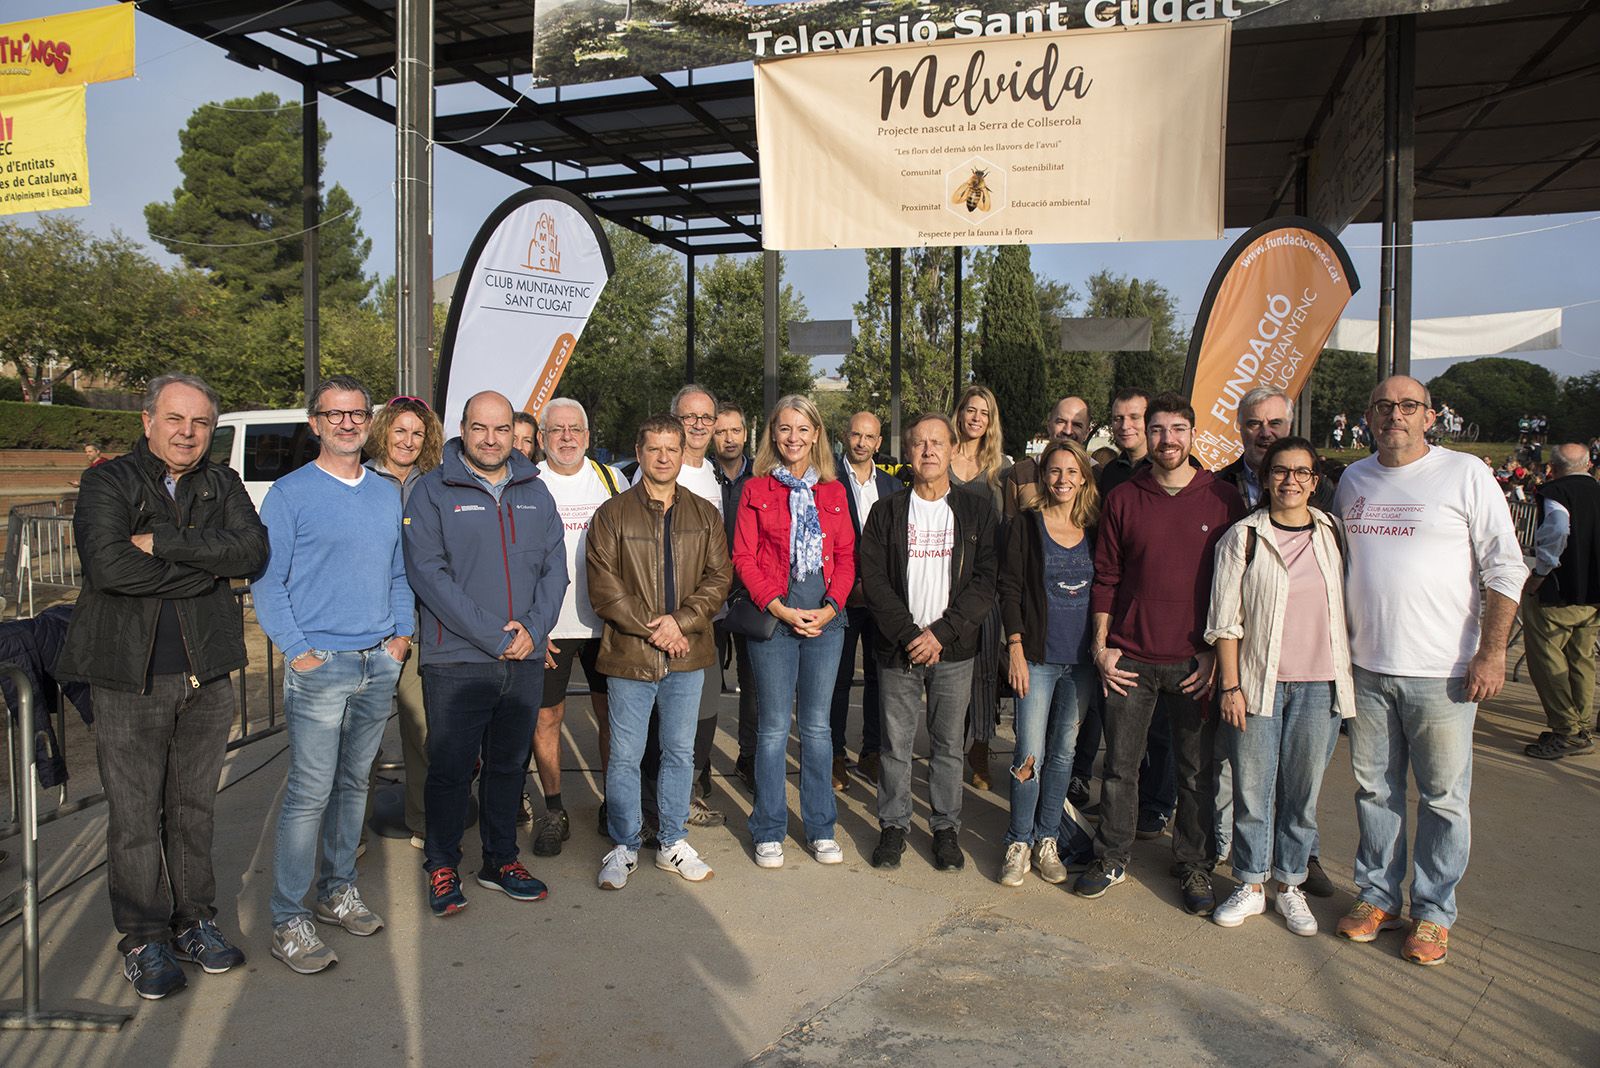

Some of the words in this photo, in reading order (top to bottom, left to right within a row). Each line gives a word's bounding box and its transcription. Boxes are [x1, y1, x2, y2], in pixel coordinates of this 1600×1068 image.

[748, 13, 939, 57] Televisió
[954, 1, 1068, 39] Sant
[1084, 0, 1242, 29] Cugat
[869, 43, 1093, 121] Melvida
[877, 126, 919, 138] Projecte
[921, 123, 956, 134] nascut
[958, 124, 965, 132] a
[967, 121, 977, 132] la
[979, 121, 1008, 131] Serra
[1010, 118, 1025, 129] de
[1026, 115, 1082, 128] Collserola
[911, 147, 929, 155] flors
[930, 146, 943, 154] del
[944, 145, 966, 154] demà
[967, 143, 982, 152] són
[983, 143, 994, 151] les
[995, 142, 1023, 151] llavors
[1024, 142, 1035, 150] de
[6, 158, 55, 173] d'Entitats
[900, 169, 942, 177] Comunitat
[1011, 163, 1065, 172] Sostenibilitat
[13, 176, 25, 187] de
[28, 172, 78, 186] Catalunya
[4, 191, 45, 202] d'Alpinisme
[52, 186, 83, 197] Escalada
[901, 203, 942, 212] Proximitat
[1011, 199, 1048, 208] Educació
[1049, 198, 1091, 207] ambiental
[918, 230, 952, 239] Respecte
[953, 230, 967, 239] per
[967, 229, 975, 237] la
[976, 228, 999, 236] fauna
[1005, 228, 1013, 236] la
[1014, 227, 1033, 236] flora
[485, 275, 514, 289] CLUB
[516, 280, 591, 299] MUNTANYENC
[505, 293, 533, 308] SANT
[536, 297, 573, 312] CUGAT
[1210, 293, 1292, 425] FUNDACIÓ
[1274, 346, 1305, 391] UGAT
[1346, 525, 1416, 537] VOLUNTARIAT
